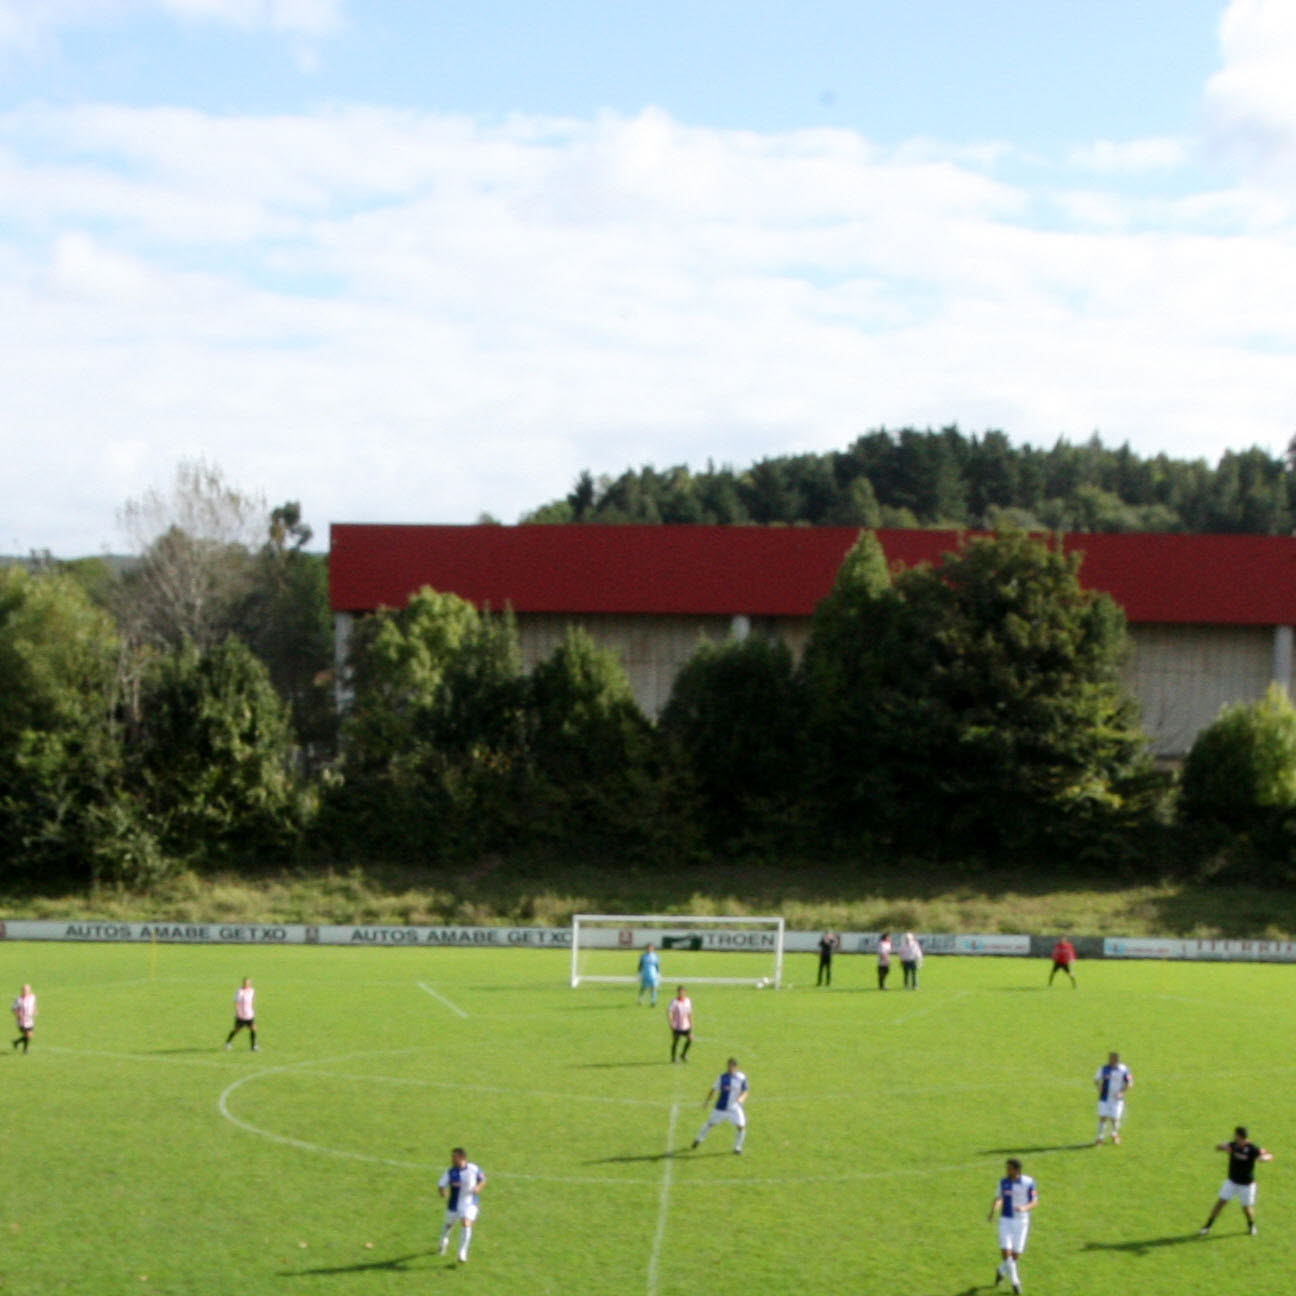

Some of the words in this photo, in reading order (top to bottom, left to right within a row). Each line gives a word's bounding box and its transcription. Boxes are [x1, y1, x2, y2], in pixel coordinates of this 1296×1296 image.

[65, 925, 132, 938] AUTOS
[140, 925, 211, 939] AMABE
[218, 926, 287, 940] GETXO
[351, 928, 418, 942] AUTOS
[427, 929, 498, 943] AMABE
